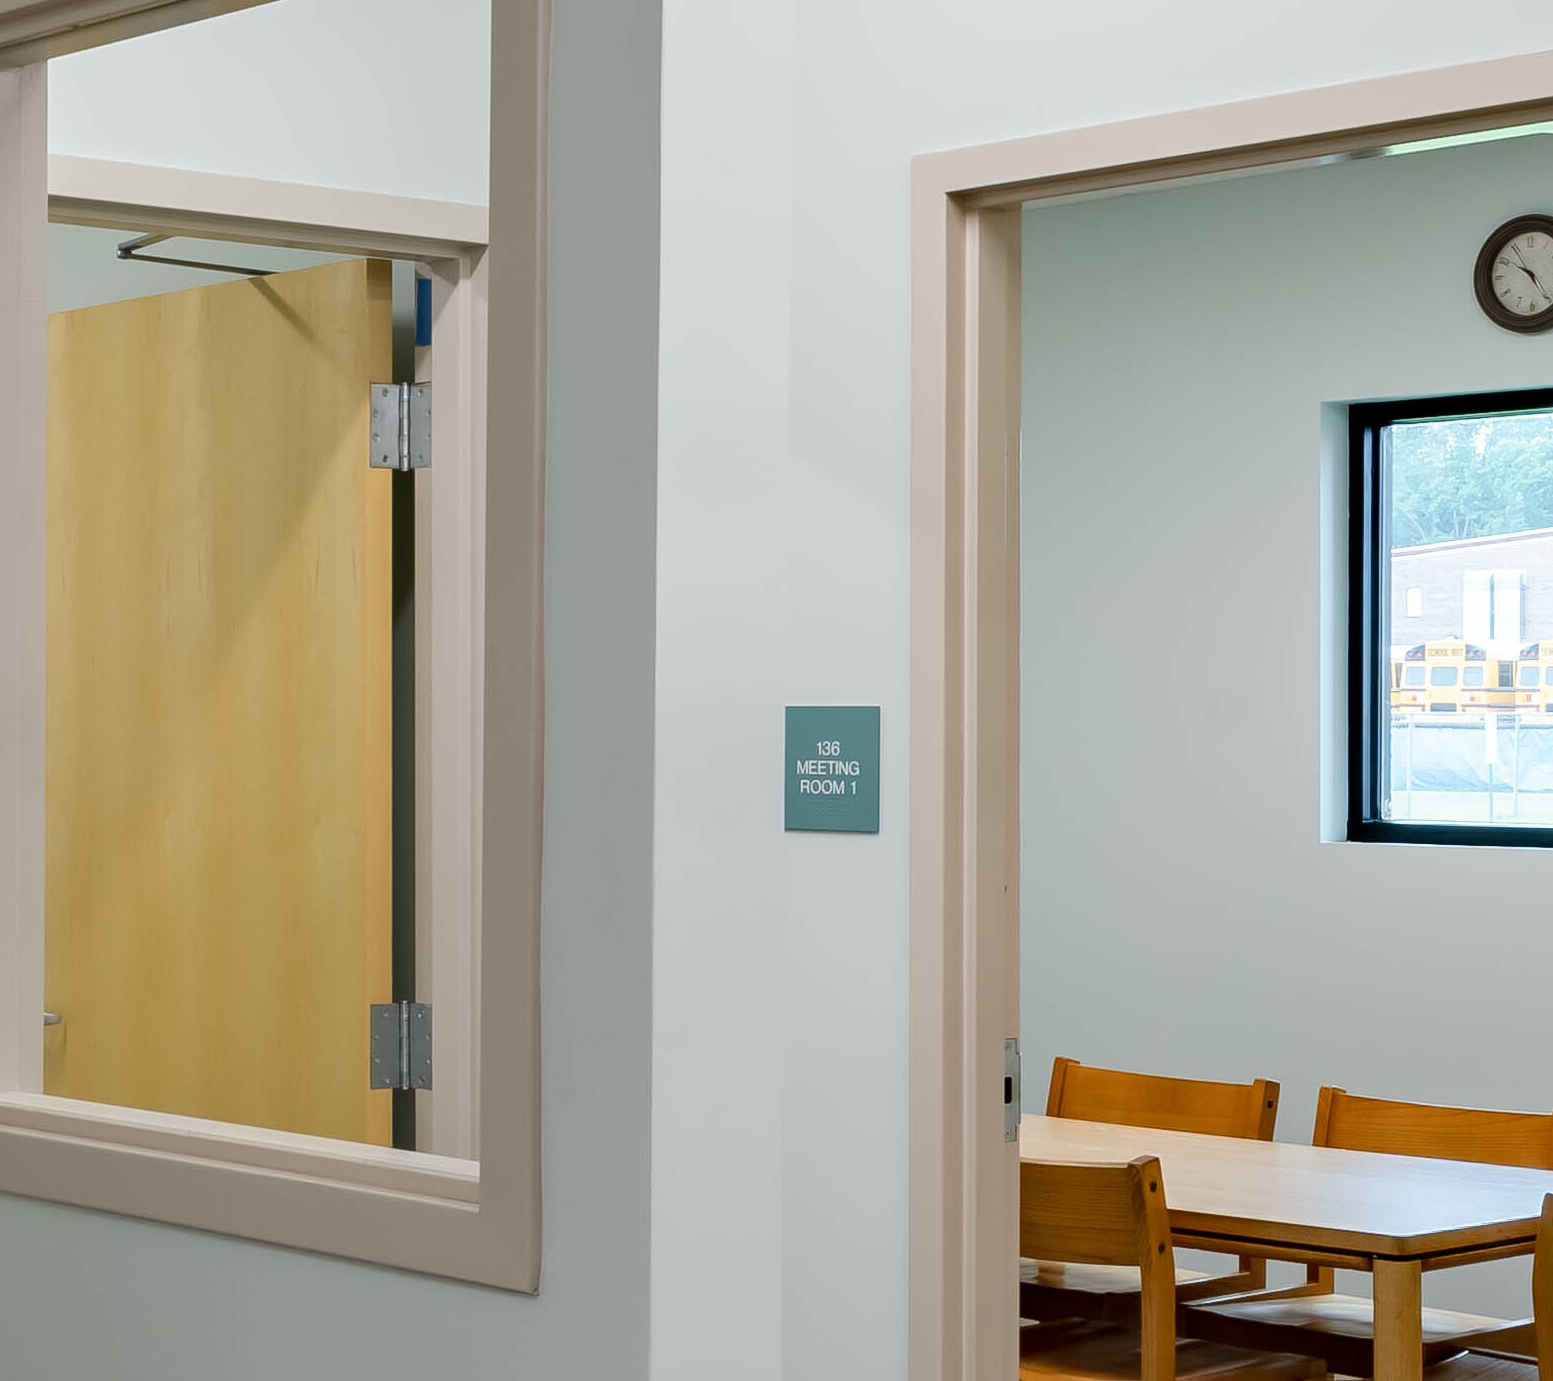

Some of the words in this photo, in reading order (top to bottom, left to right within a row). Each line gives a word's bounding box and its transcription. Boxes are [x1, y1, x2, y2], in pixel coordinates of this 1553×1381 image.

[816, 740, 841, 756] 136
[796, 760, 860, 776] MEETING
[800, 779, 845, 795] ROOM
[850, 781, 857, 795] 1
